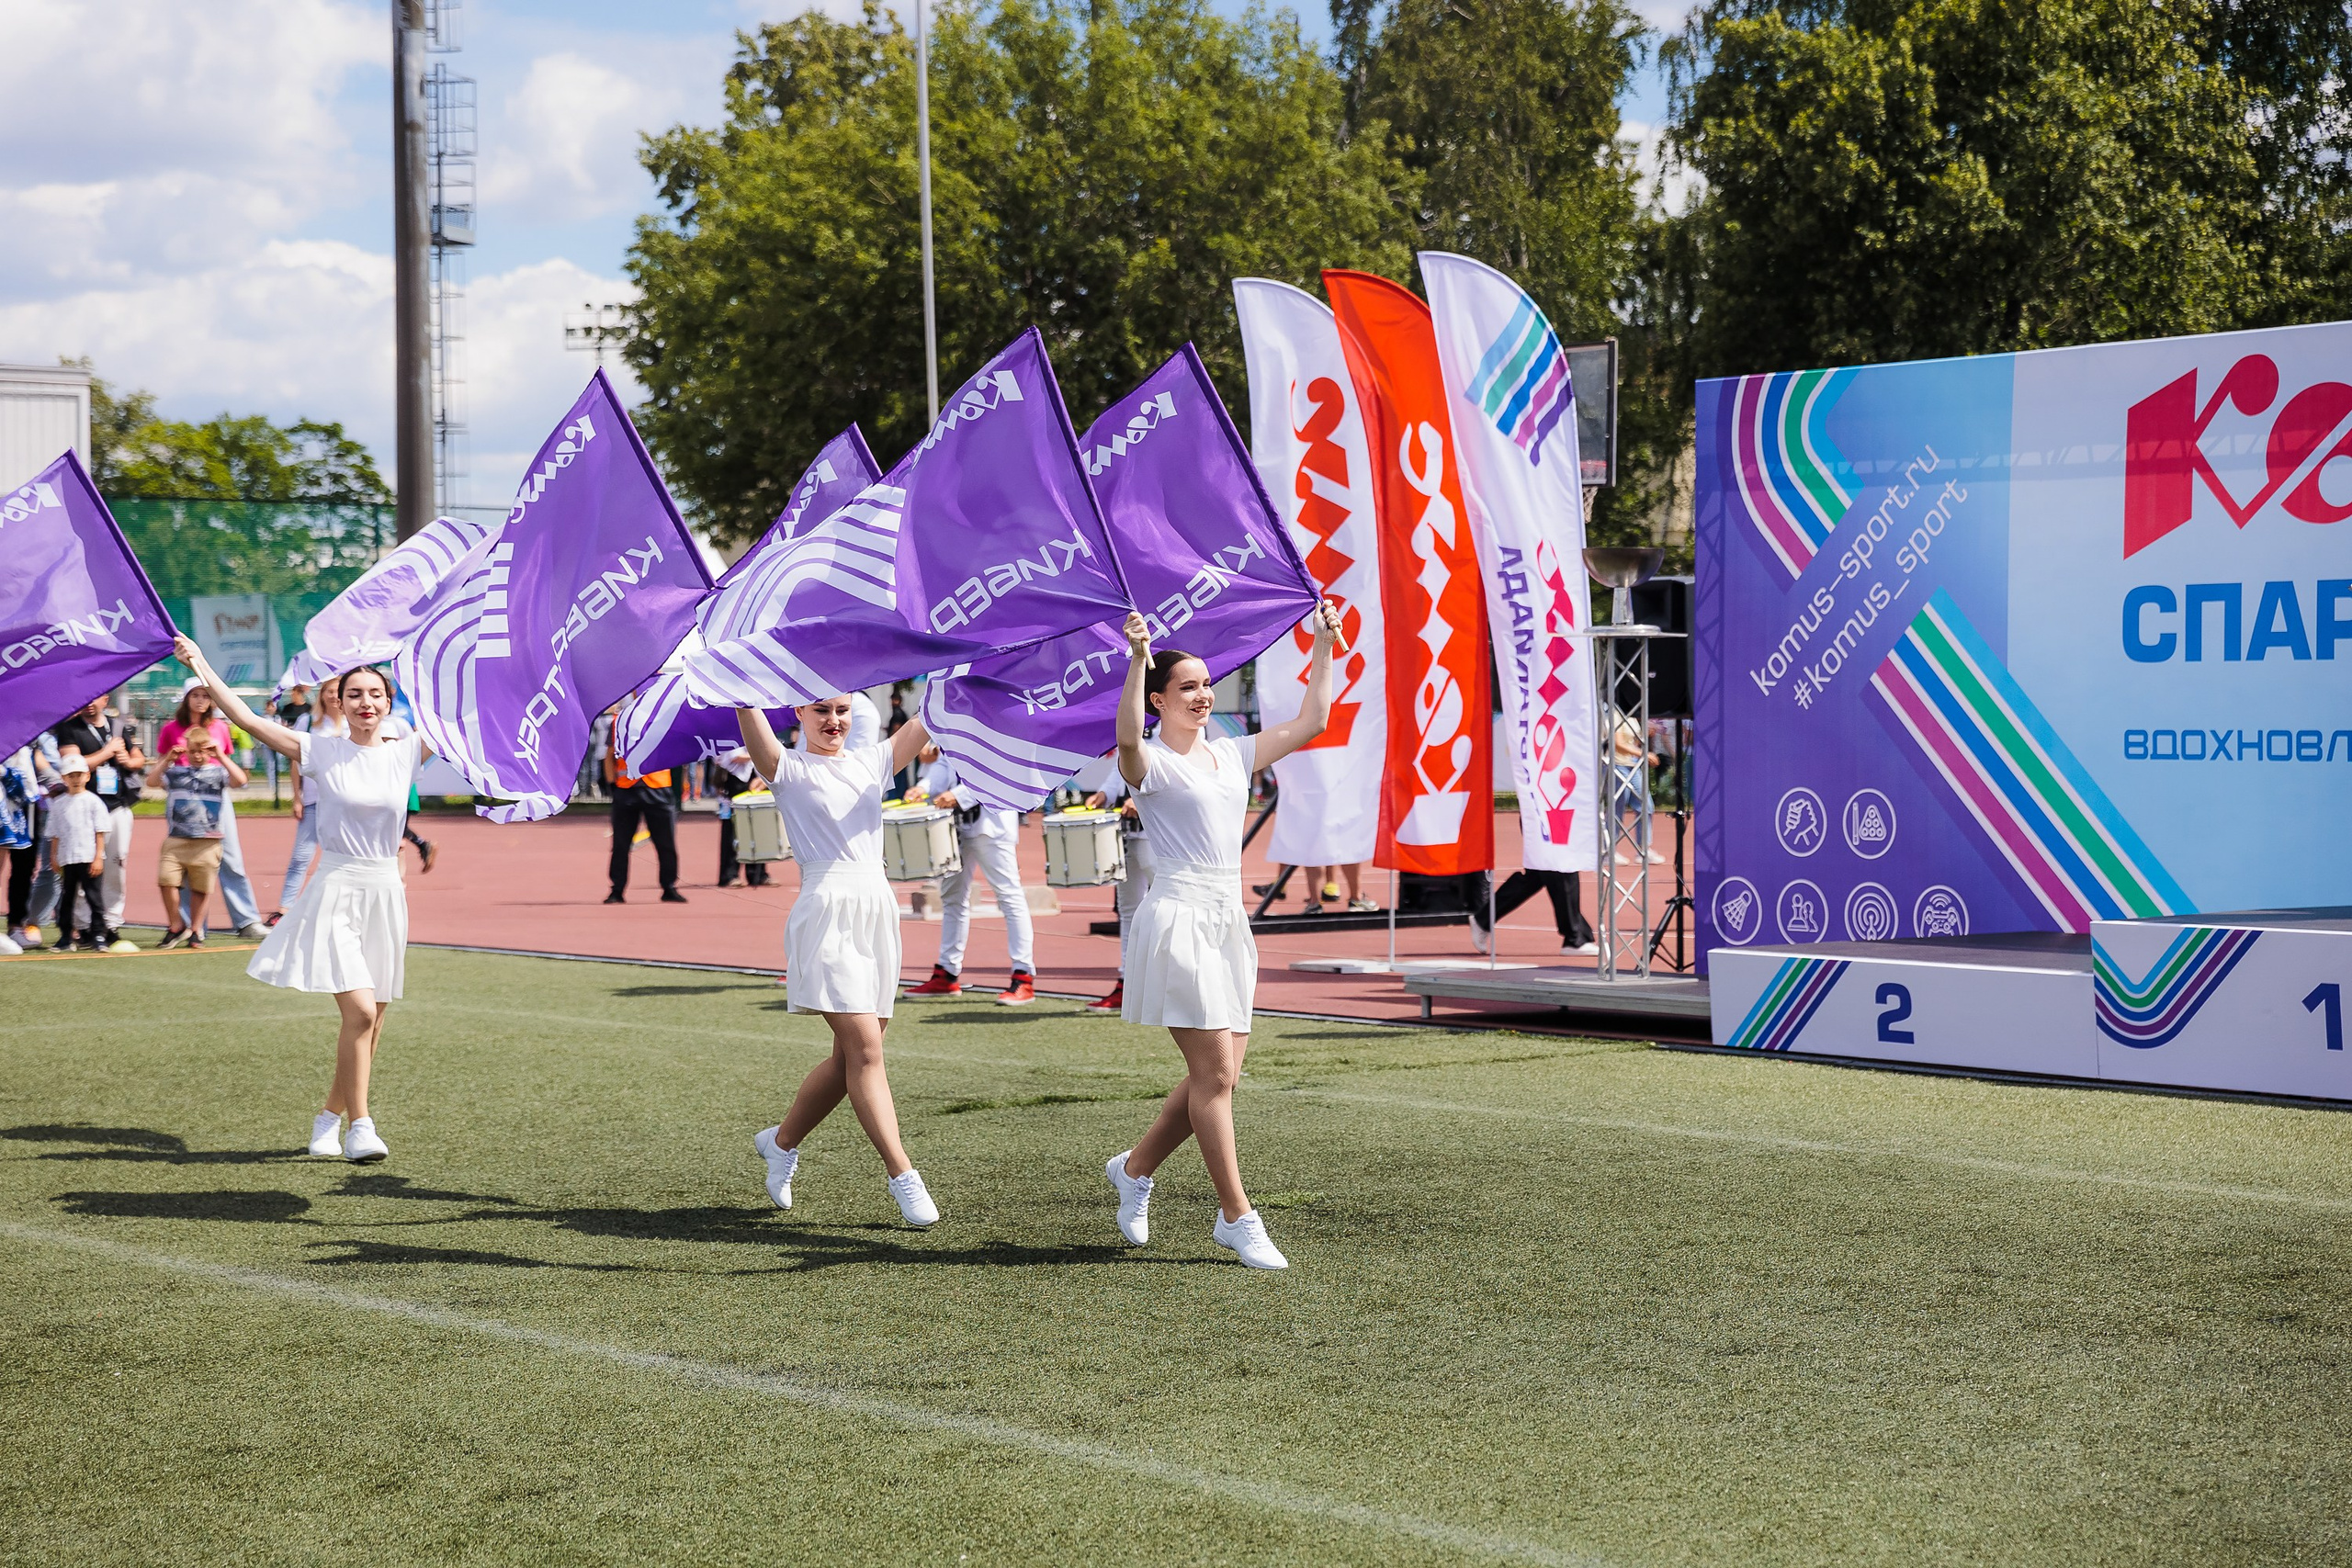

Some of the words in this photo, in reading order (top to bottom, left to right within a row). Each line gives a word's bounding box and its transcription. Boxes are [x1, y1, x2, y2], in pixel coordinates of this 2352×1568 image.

[1749, 445, 1939, 696] komus-sport.ru
[1793, 479, 1968, 709] #komus_sport
[1875, 982, 1915, 1044] 2
[2301, 983, 2343, 1051] 1
